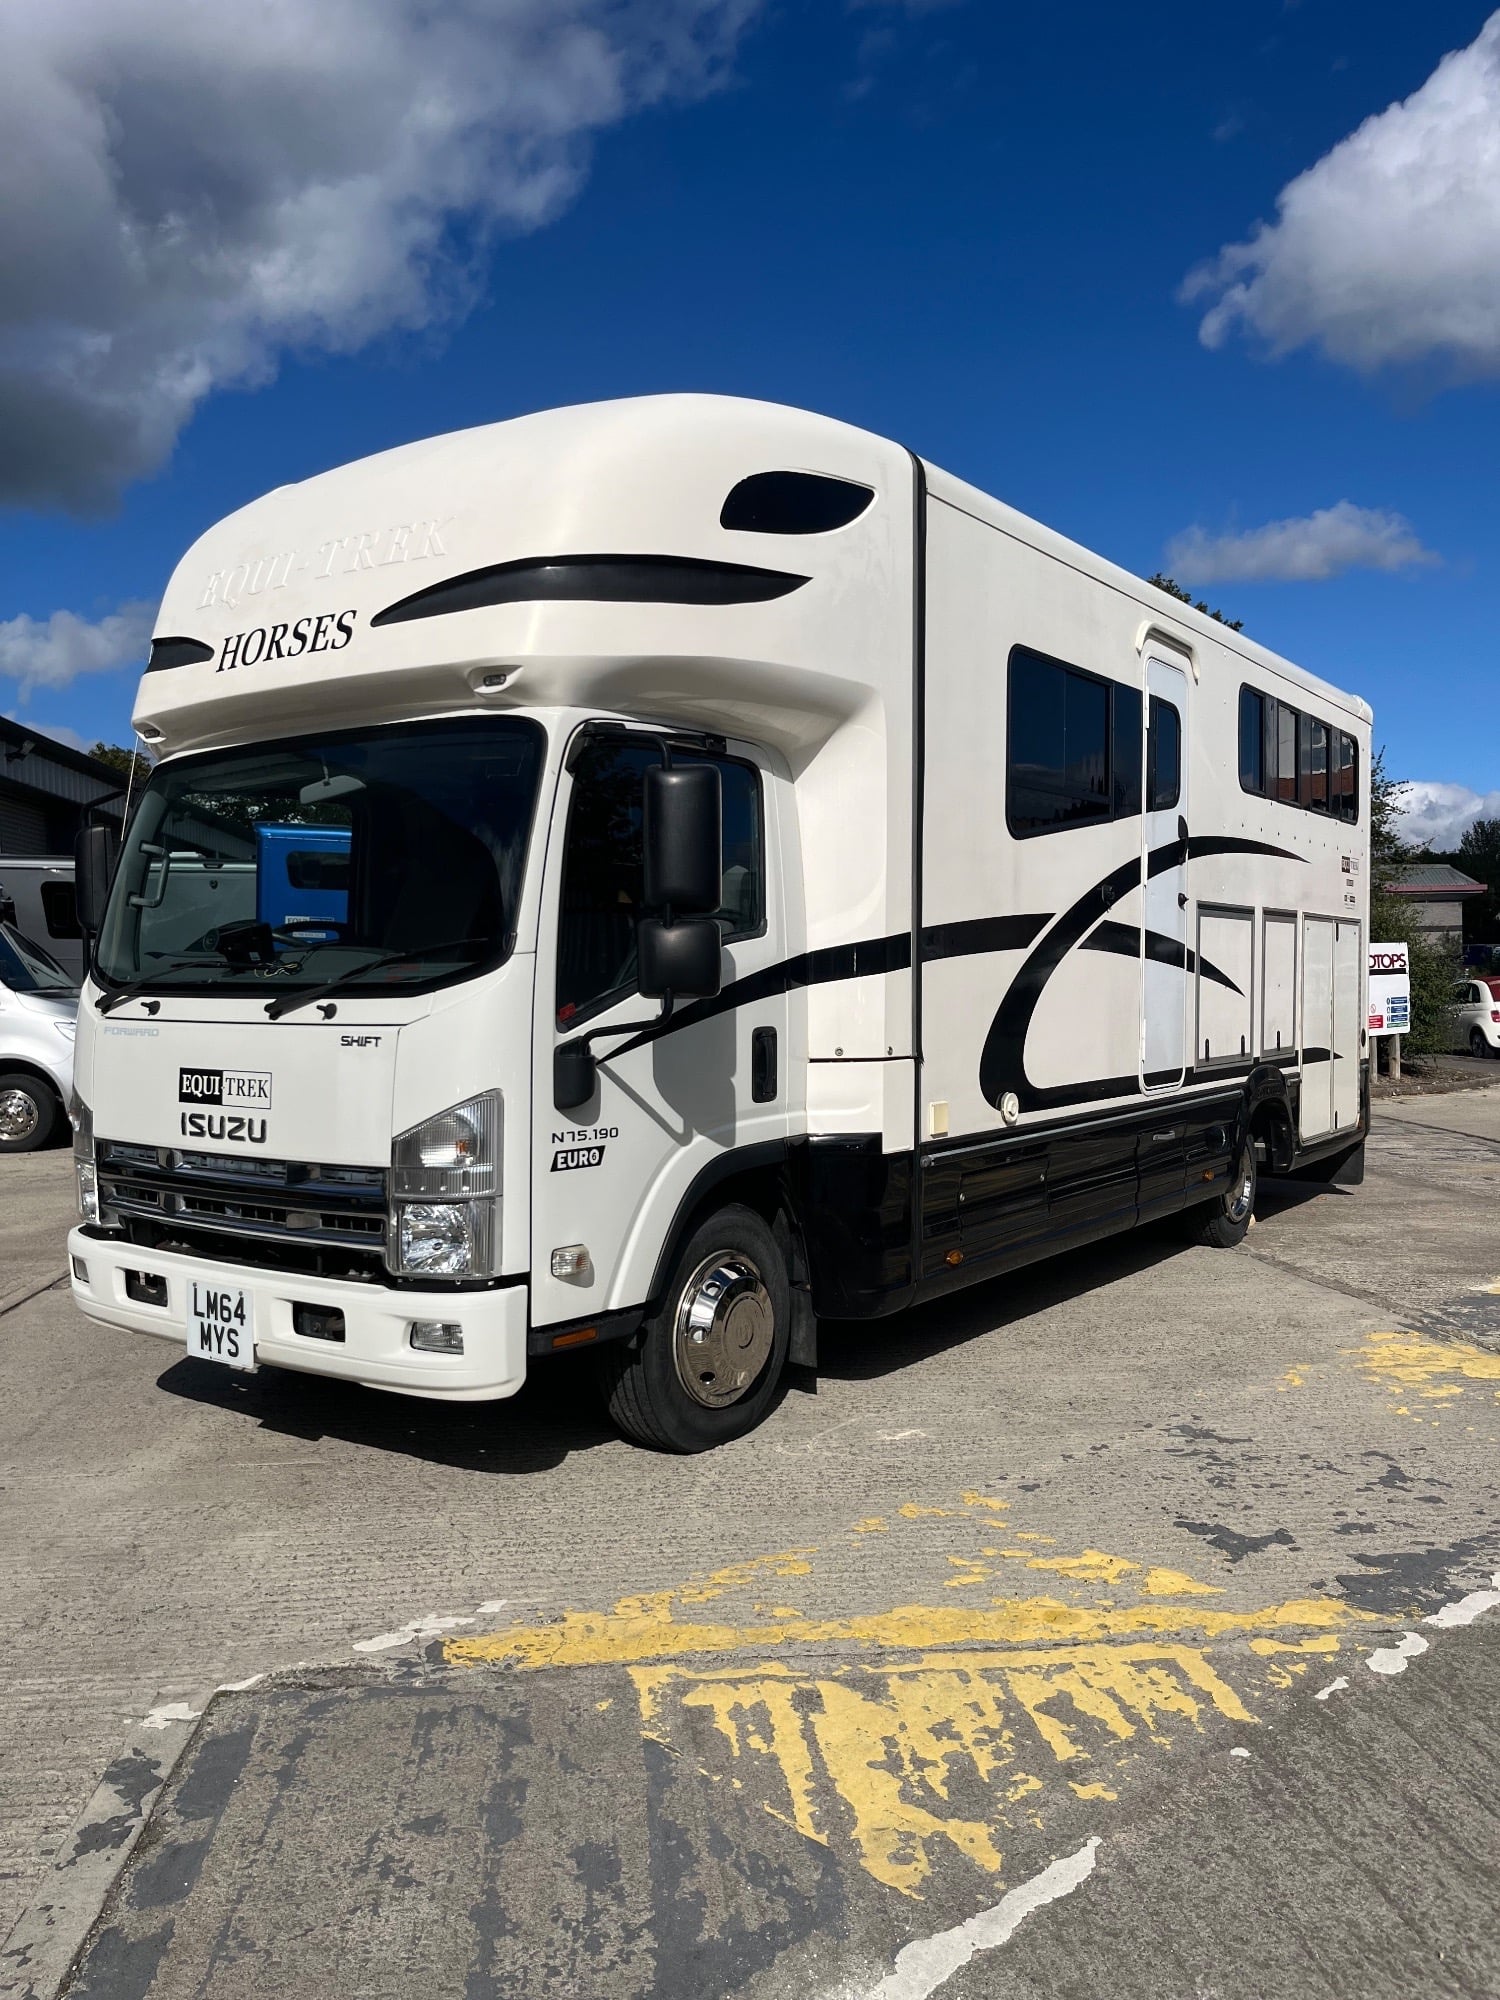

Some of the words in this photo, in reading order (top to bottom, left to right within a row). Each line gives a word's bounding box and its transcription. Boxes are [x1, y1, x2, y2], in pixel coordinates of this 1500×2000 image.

[215, 609, 358, 673] HORSES
[104, 1026, 160, 1037] FORWARD
[340, 1035, 382, 1048] SHIFT
[181, 1111, 267, 1144] ISUZU
[551, 1127, 619, 1144] N75.190
[194, 1287, 246, 1326] LM64
[200, 1321, 240, 1358] MYS
